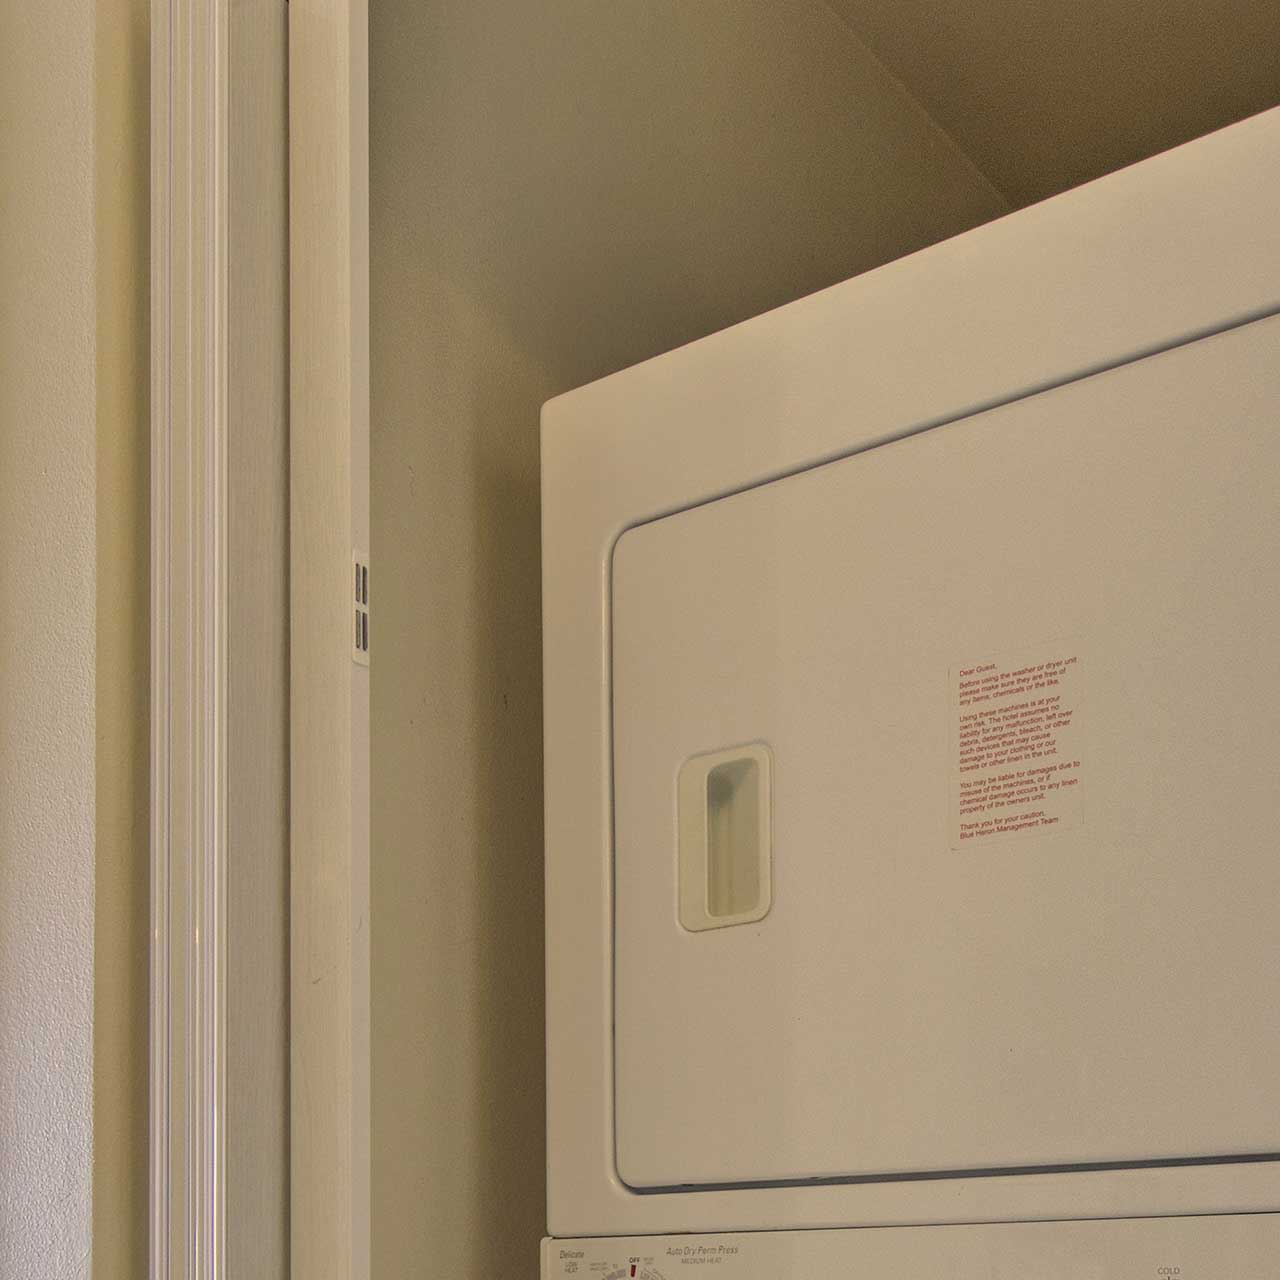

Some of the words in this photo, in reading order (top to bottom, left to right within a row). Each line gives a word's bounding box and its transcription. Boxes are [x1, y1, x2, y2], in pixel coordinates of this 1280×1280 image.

[960, 669, 974, 677] Dear
[960, 680, 979, 689] Before
[980, 676, 998, 684] using
[1012, 667, 1035, 677] washer
[1045, 661, 1062, 670] dryer
[960, 689, 979, 699] please
[981, 684, 998, 693] make
[1016, 677, 1029, 685] they
[992, 687, 1024, 698] chemicals
[960, 714, 977, 722] Using
[979, 710, 996, 718] these
[998, 703, 1029, 714] machines
[1046, 696, 1060, 705] your
[1002, 712, 1018, 720] hotel
[1020, 707, 1049, 717] assumes
[1052, 720, 1070, 728] other
[960, 747, 974, 755] such
[976, 743, 1000, 752] devices
[1001, 739, 1014, 747] that
[1030, 733, 1050, 741] cause
[960, 755, 984, 763] damage
[994, 750, 1008, 759] your
[1010, 745, 1034, 754] clothing
[960, 763, 979, 772] towels
[998, 773, 1014, 781] liable
[1026, 766, 1057, 776] damages
[960, 789, 981, 797] misuse
[960, 795, 987, 805] chemical
[988, 791, 1014, 800] damage
[1016, 787, 1037, 795] occurs
[960, 804, 985, 815] property
[960, 821, 979, 830] Thank
[1004, 816, 1018, 824] your
[960, 831, 974, 839] Blue
[975, 828, 995, 836] Heron
[996, 819, 1039, 833] Management
[666, 1247, 682, 1255] Auto
[684, 1247, 695, 1256] Dry
[718, 1246, 738, 1254] Press
[1157, 1267, 1180, 1275] COLD
